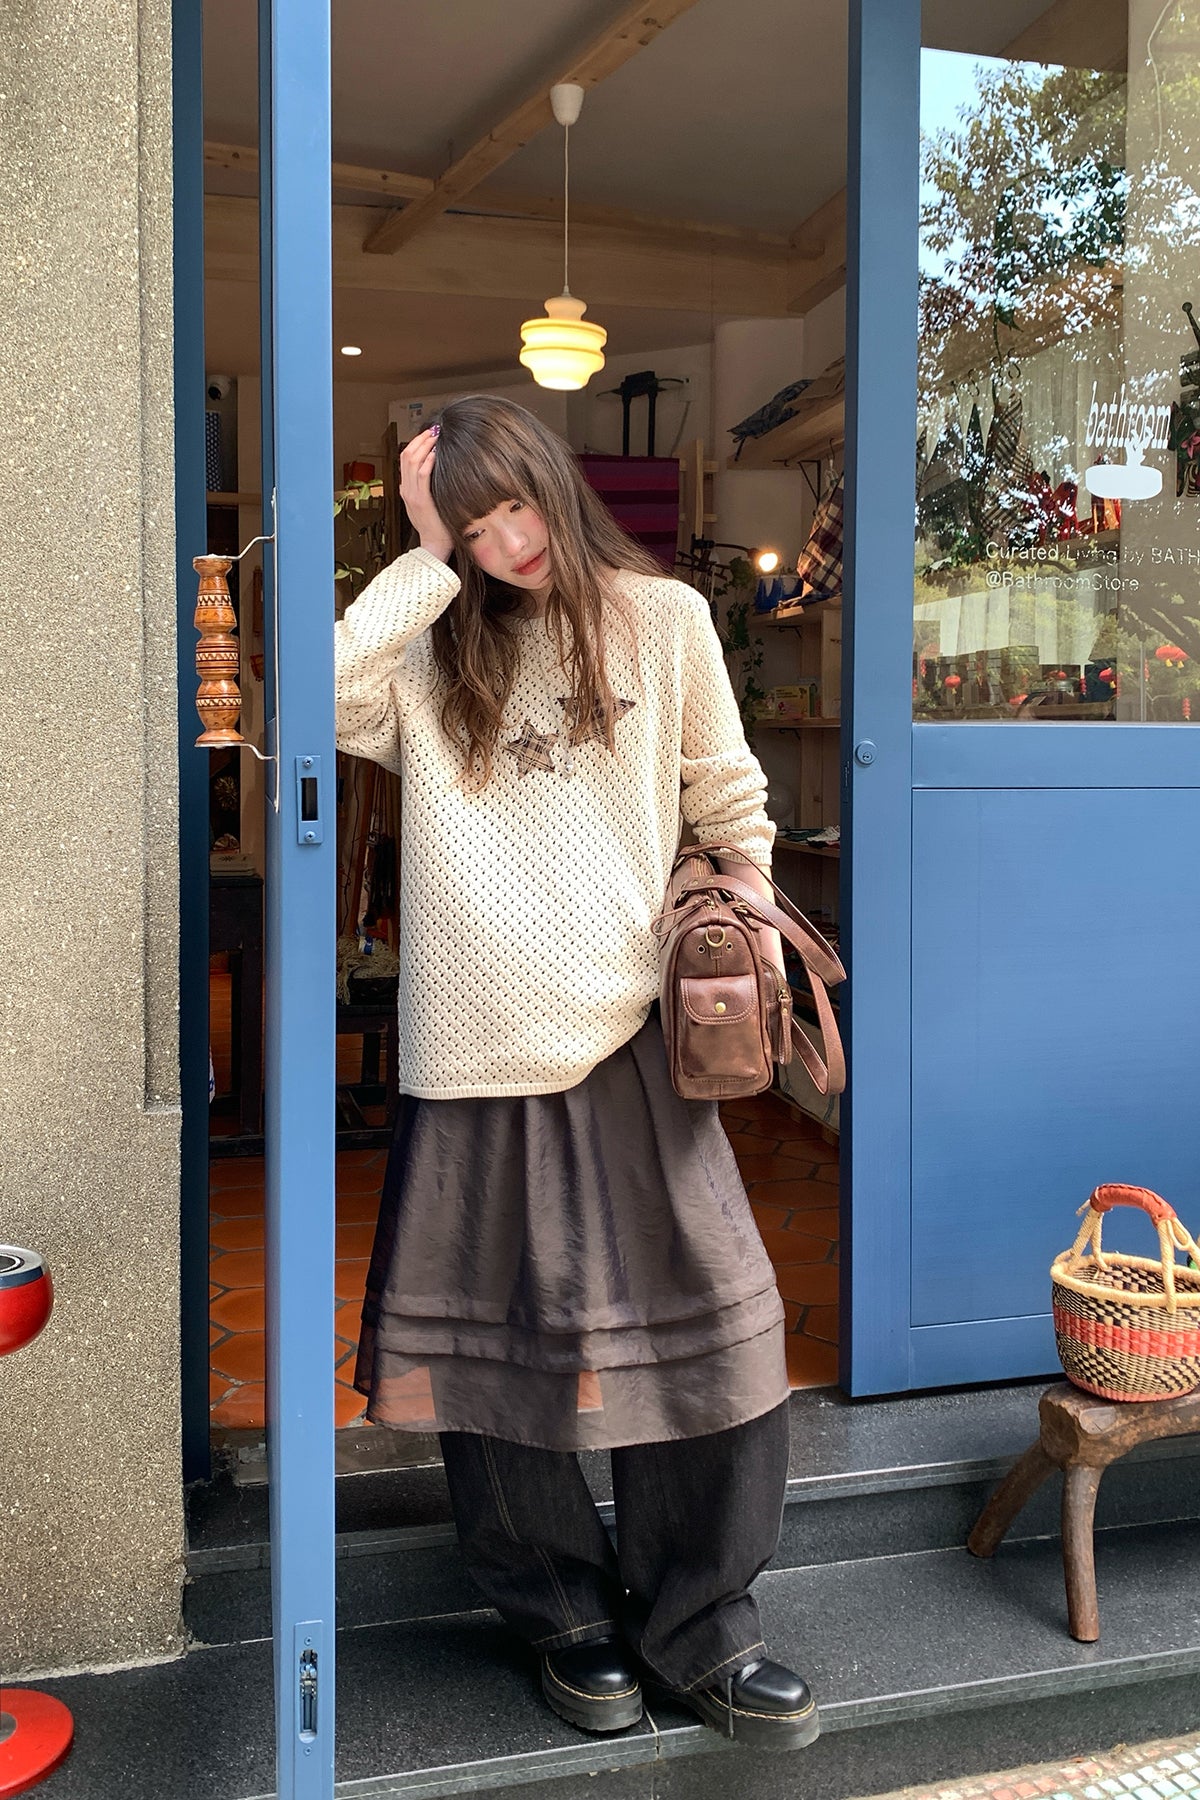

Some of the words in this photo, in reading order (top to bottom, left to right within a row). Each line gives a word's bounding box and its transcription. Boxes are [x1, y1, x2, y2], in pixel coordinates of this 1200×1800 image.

[1085, 380, 1171, 449] bathroom
[985, 541, 1059, 561] Curated
[1066, 545, 1117, 567] Living
[1124, 547, 1144, 566] by
[985, 571, 1140, 591] @BathroomStore
